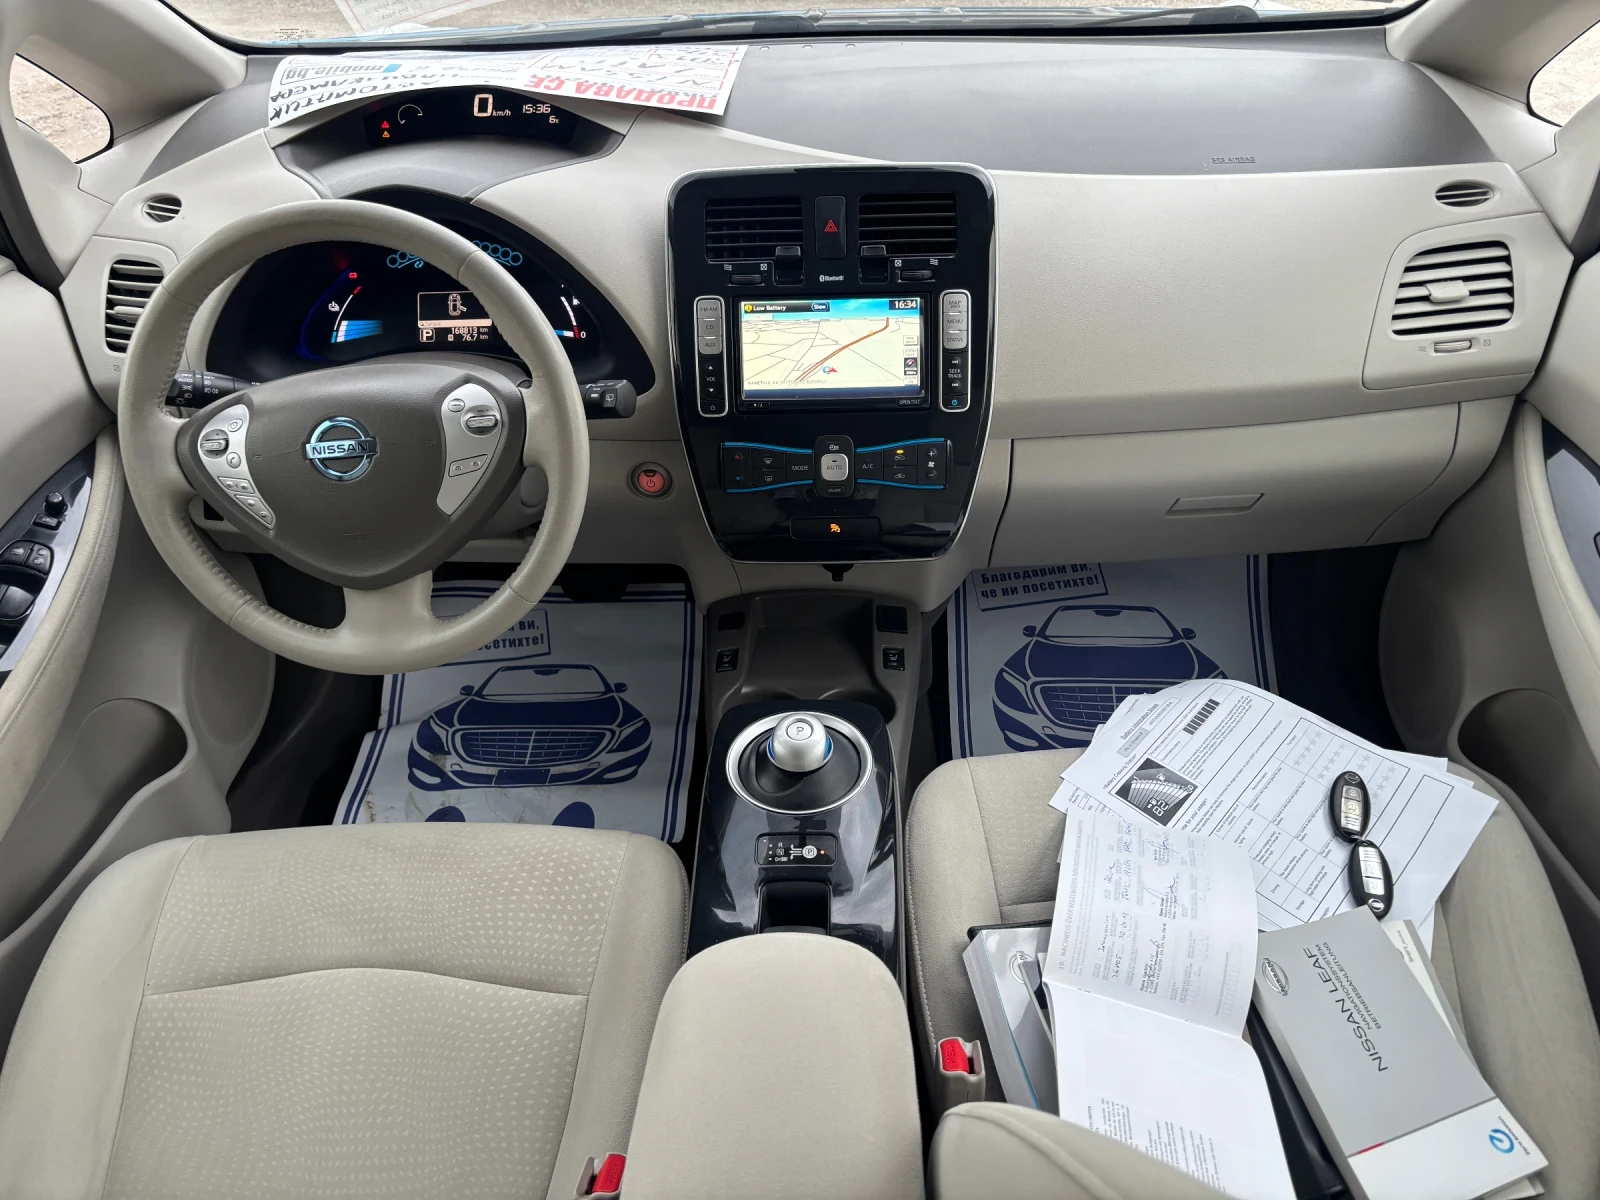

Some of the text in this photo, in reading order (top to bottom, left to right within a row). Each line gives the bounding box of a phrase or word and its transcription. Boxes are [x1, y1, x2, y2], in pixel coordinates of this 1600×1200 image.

[284, 64, 382, 81] mobile.bg
[523, 75, 716, 109] ПРОДАВА СЕ
[474, 94, 493, 117] 0
[522, 104, 551, 114] 15:36
[766, 304, 786, 312] Battery
[894, 300, 916, 308] 16:34
[312, 442, 369, 456] NISSAN
[980, 565, 1068, 584] Благодарим
[980, 574, 1100, 599] че ни посетихте!
[796, 726, 804, 735] P
[1120, 728, 1134, 740] Battery
[1064, 908, 1073, 923] ÜBER
[1060, 924, 1071, 956] NACHWEIS
[1315, 944, 1373, 1030] NAVIGATIONSSYSTEM
[1322, 942, 1382, 1030] BETRIEBSANLEITUNG
[1302, 947, 1388, 1072] NISSAN LEAF
